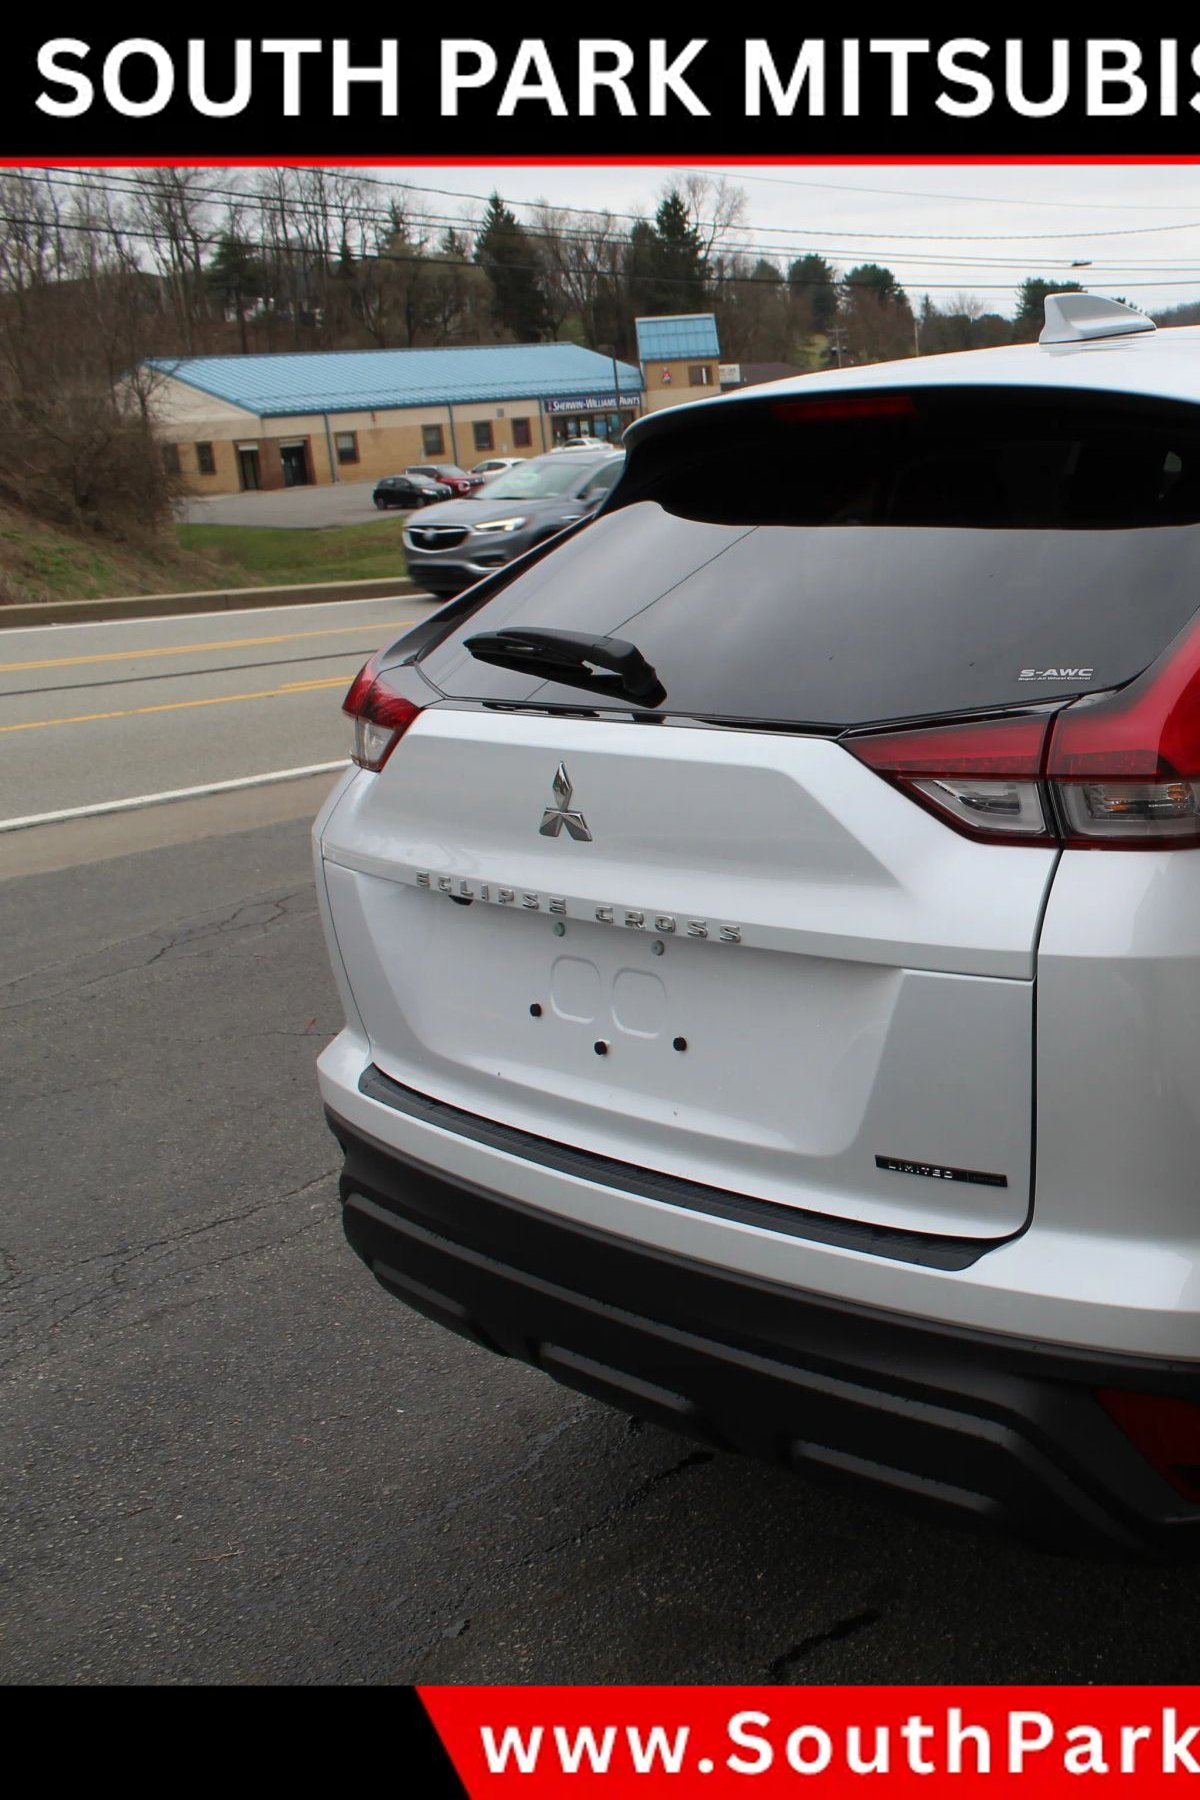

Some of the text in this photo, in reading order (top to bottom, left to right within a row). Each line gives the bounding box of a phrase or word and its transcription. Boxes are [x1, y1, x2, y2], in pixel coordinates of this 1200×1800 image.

[1020, 668, 1093, 677] S-AWC
[415, 870, 742, 944] ECLIPSE CROSS
[888, 1160, 953, 1179] LIMITED
